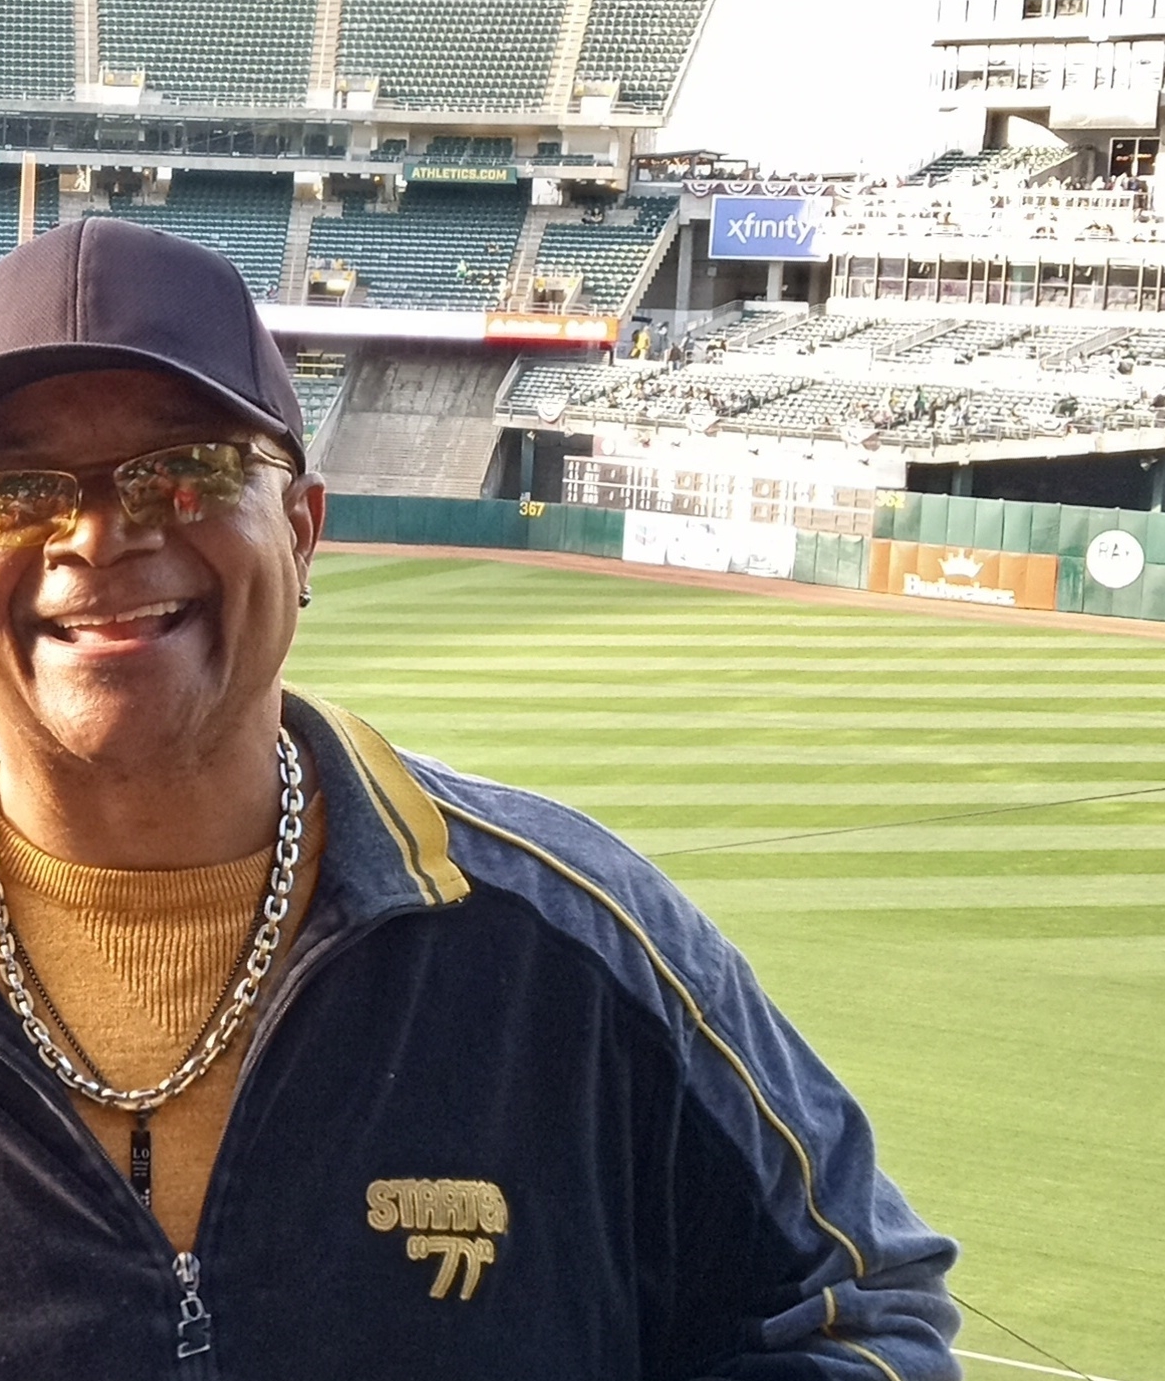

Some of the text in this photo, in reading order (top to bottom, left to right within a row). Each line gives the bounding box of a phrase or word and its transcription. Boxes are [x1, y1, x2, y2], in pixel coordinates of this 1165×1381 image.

[411, 166, 507, 181] ATHLETICS.COM
[726, 212, 814, 245] xfinity
[875, 491, 906, 509] 362
[519, 501, 545, 517] 367
